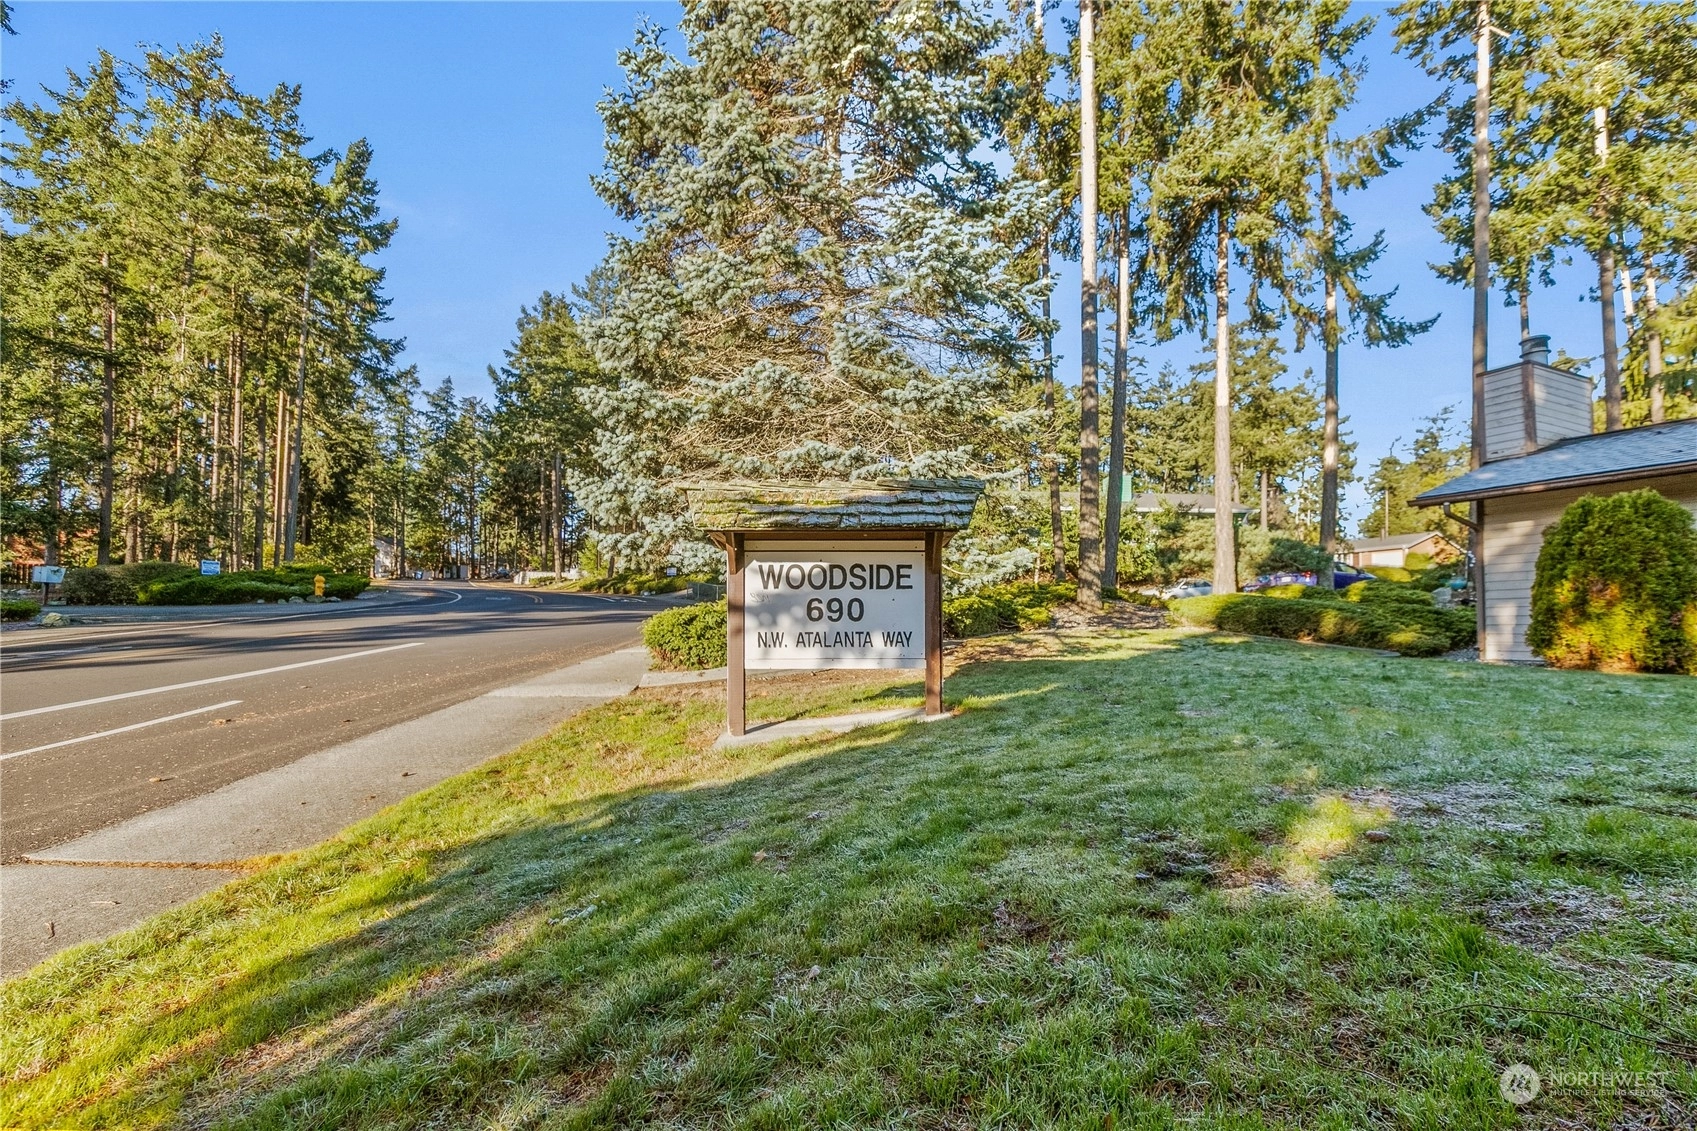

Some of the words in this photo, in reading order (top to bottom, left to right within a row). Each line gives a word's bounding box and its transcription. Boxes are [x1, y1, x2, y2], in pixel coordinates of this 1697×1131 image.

[758, 563, 913, 590] WOODSIDE
[806, 597, 865, 622] 690
[757, 631, 788, 648] N.W.
[796, 631, 873, 648] ATALANTA
[882, 631, 913, 648] WAY
